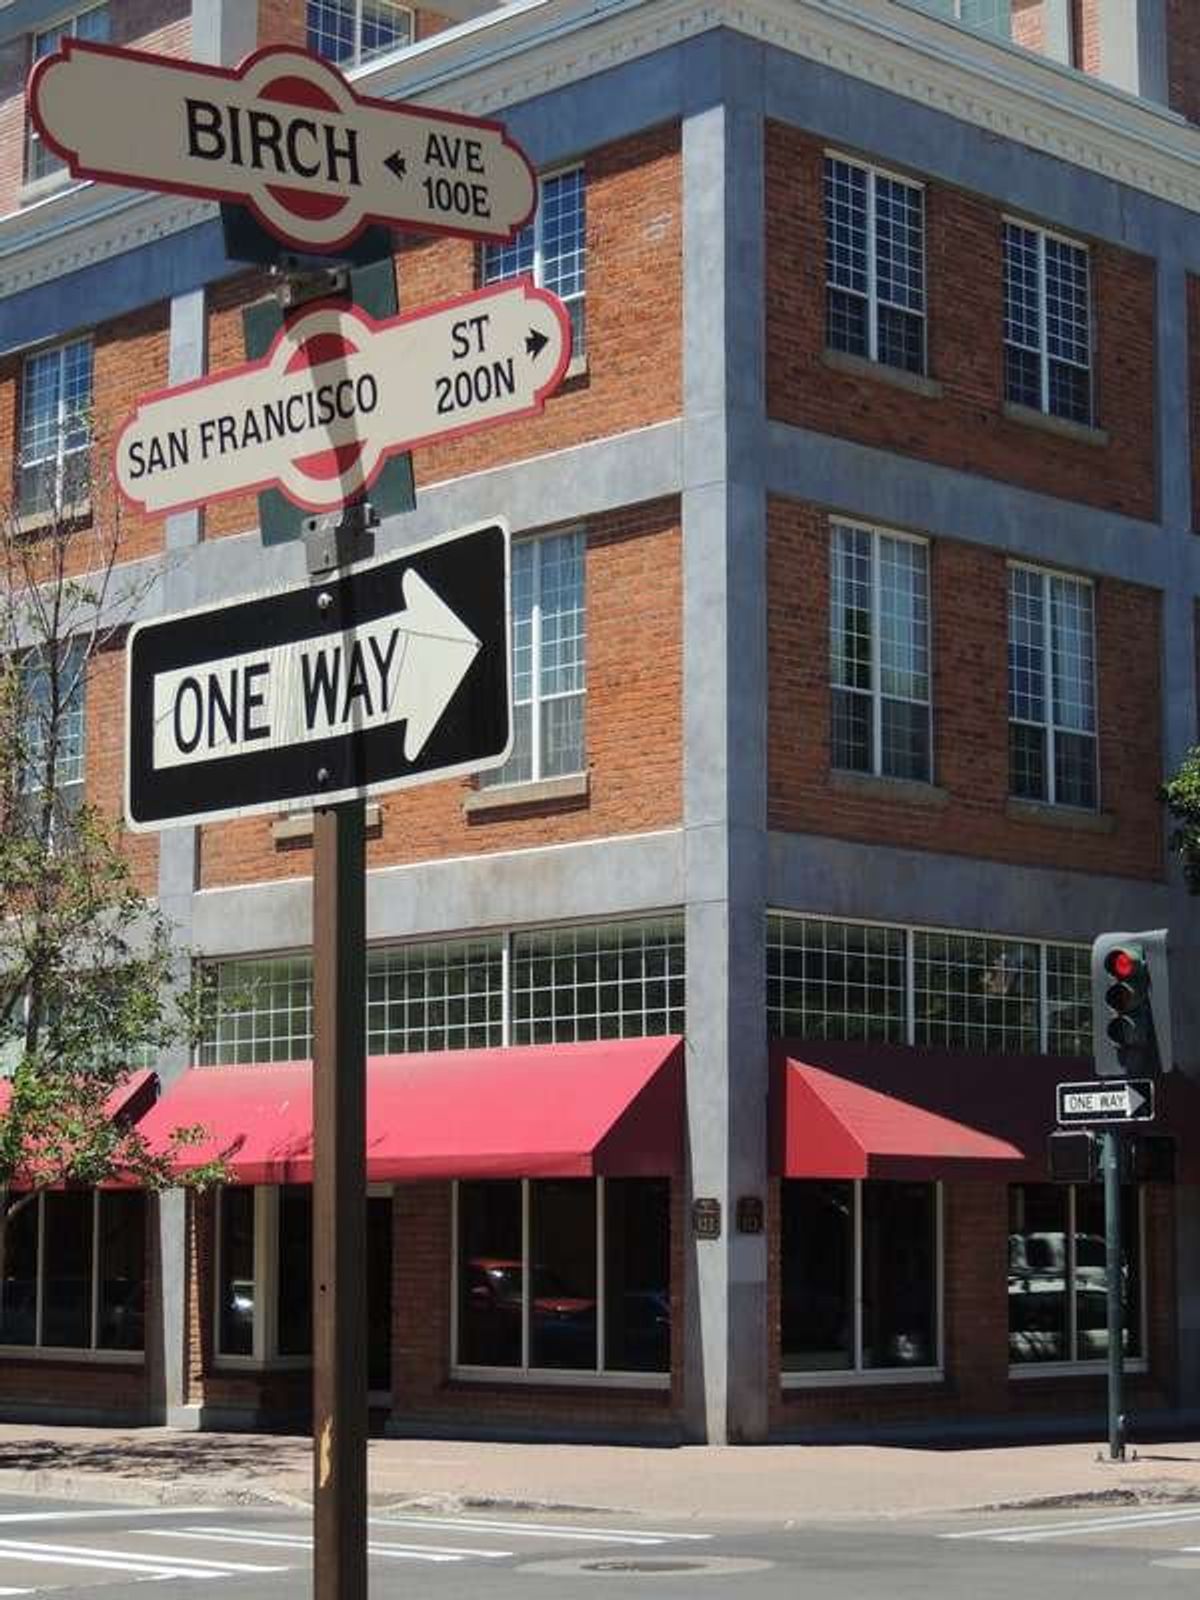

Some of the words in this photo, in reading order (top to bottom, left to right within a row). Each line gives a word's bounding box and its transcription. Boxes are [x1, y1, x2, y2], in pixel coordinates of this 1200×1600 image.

[184, 97, 362, 186] BIRCH
[424, 134, 484, 172] AVE
[423, 178, 491, 217] 100E
[451, 315, 490, 360] ST
[435, 358, 517, 416] 200N
[128, 427, 189, 480] SAN
[201, 374, 377, 459] FRANCISCO
[174, 663, 270, 754] ONE
[302, 629, 399, 729] WAY
[1070, 1096, 1093, 1110] ONE
[1100, 1093, 1125, 1108] WAY
